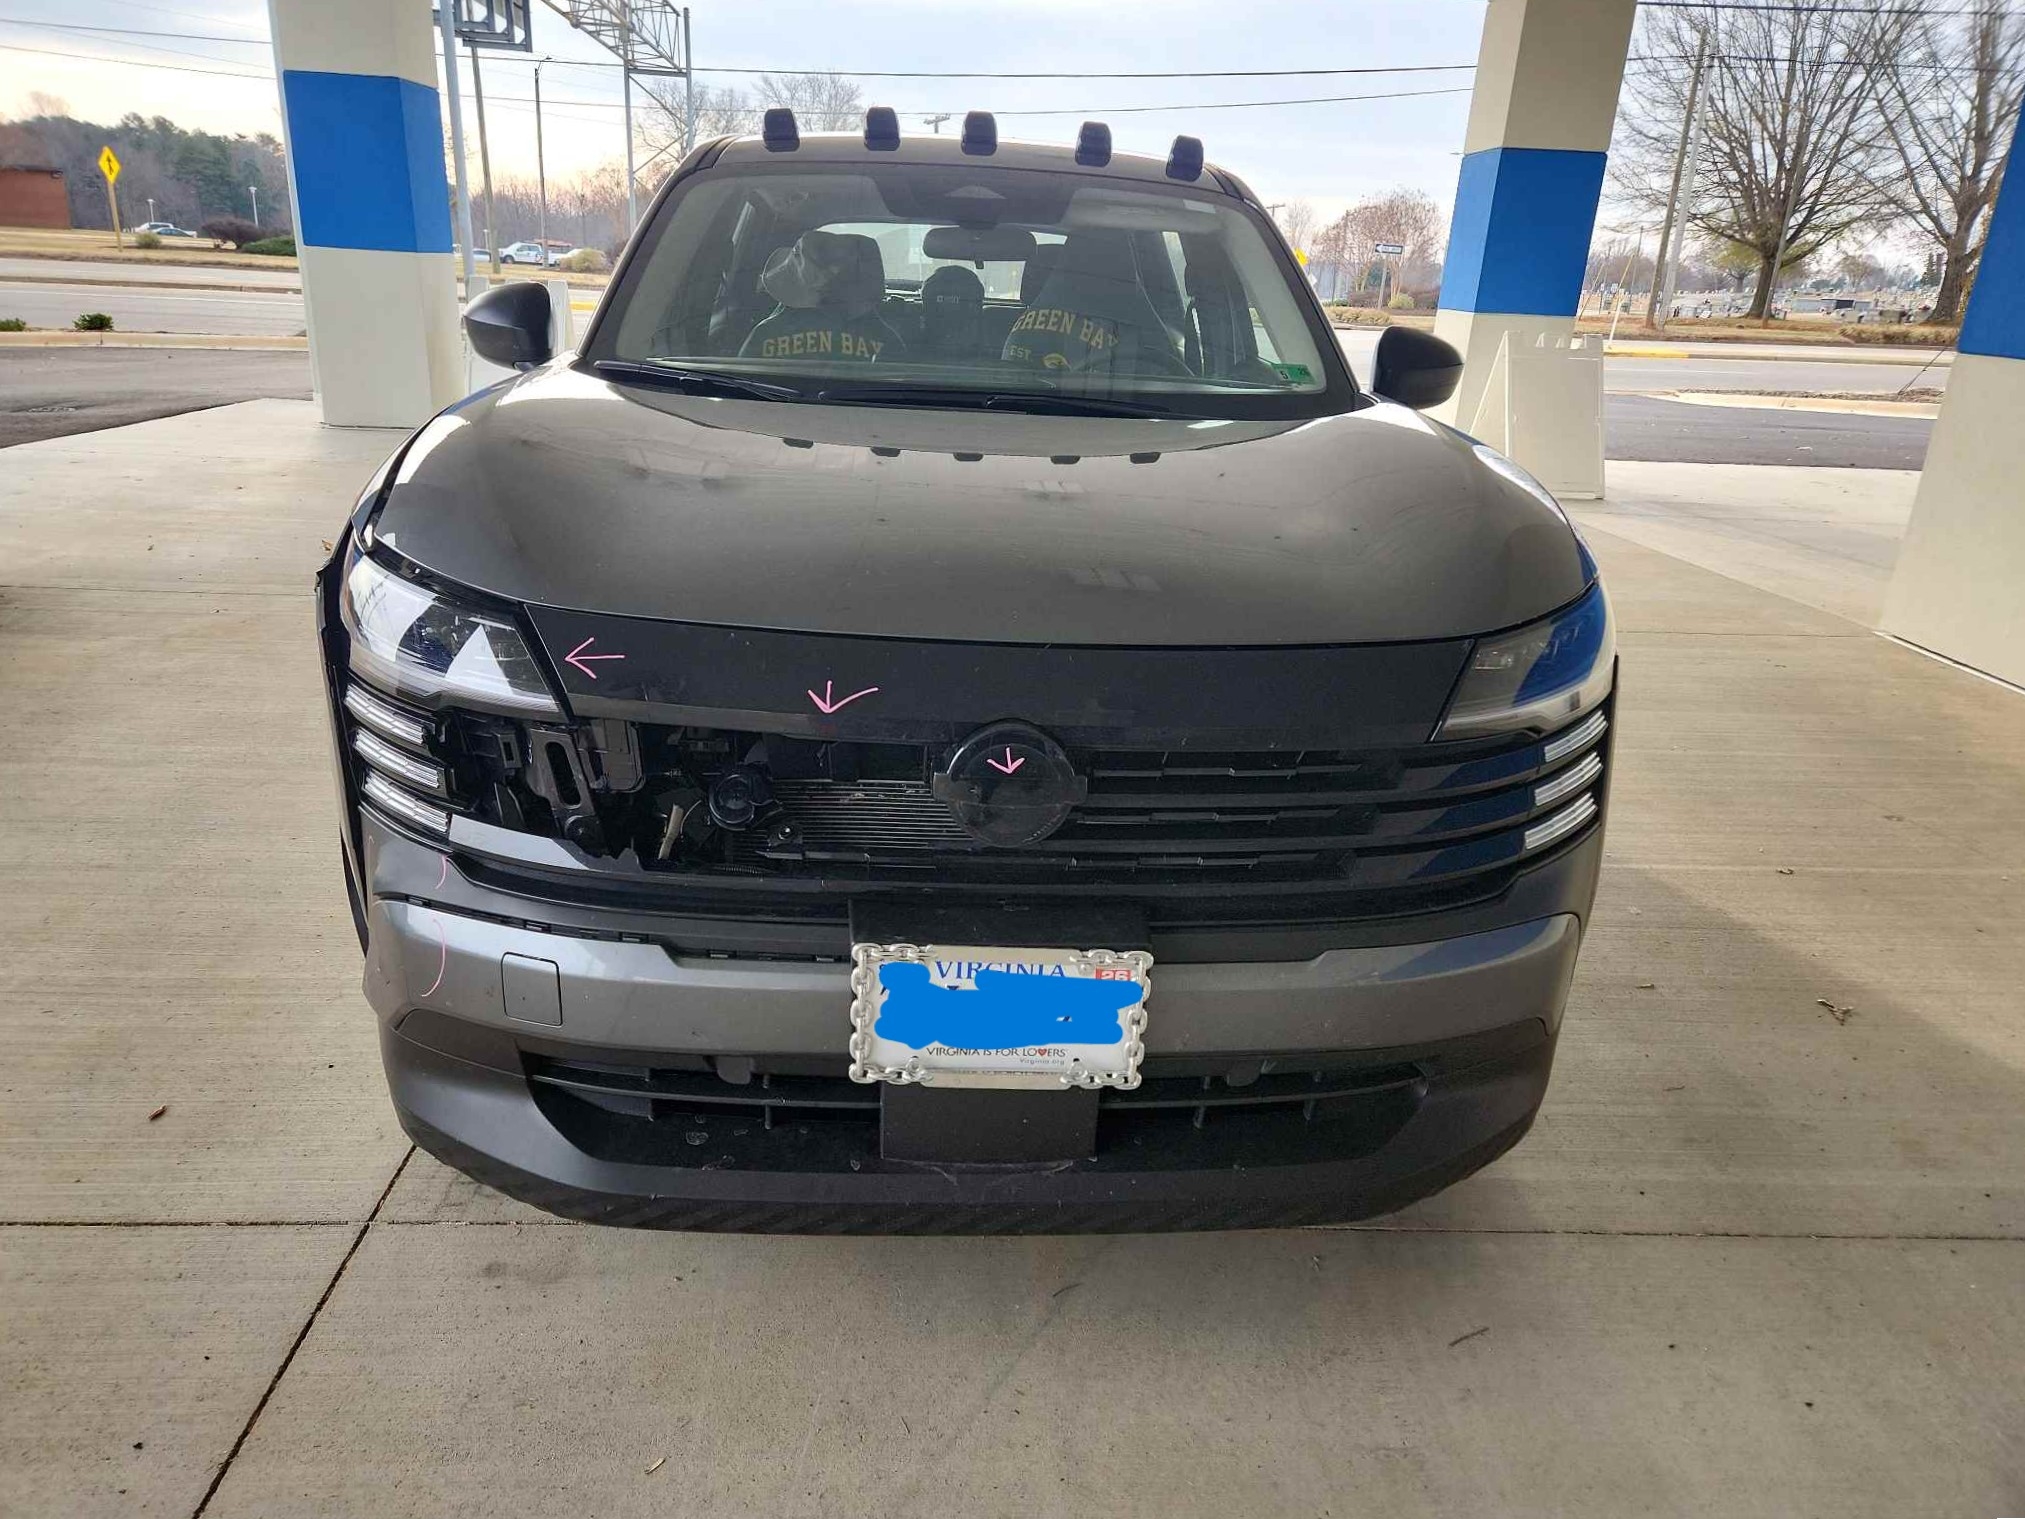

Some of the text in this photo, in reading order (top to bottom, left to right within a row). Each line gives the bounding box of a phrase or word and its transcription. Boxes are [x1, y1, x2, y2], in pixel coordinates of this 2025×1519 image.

[1011, 309, 1076, 335] GREEN
[762, 330, 885, 358] GREEN BAY
[926, 1047, 980, 1057] VIRGINIA
[983, 1048, 992, 1056] IS
[995, 1048, 1020, 1057] FOR
